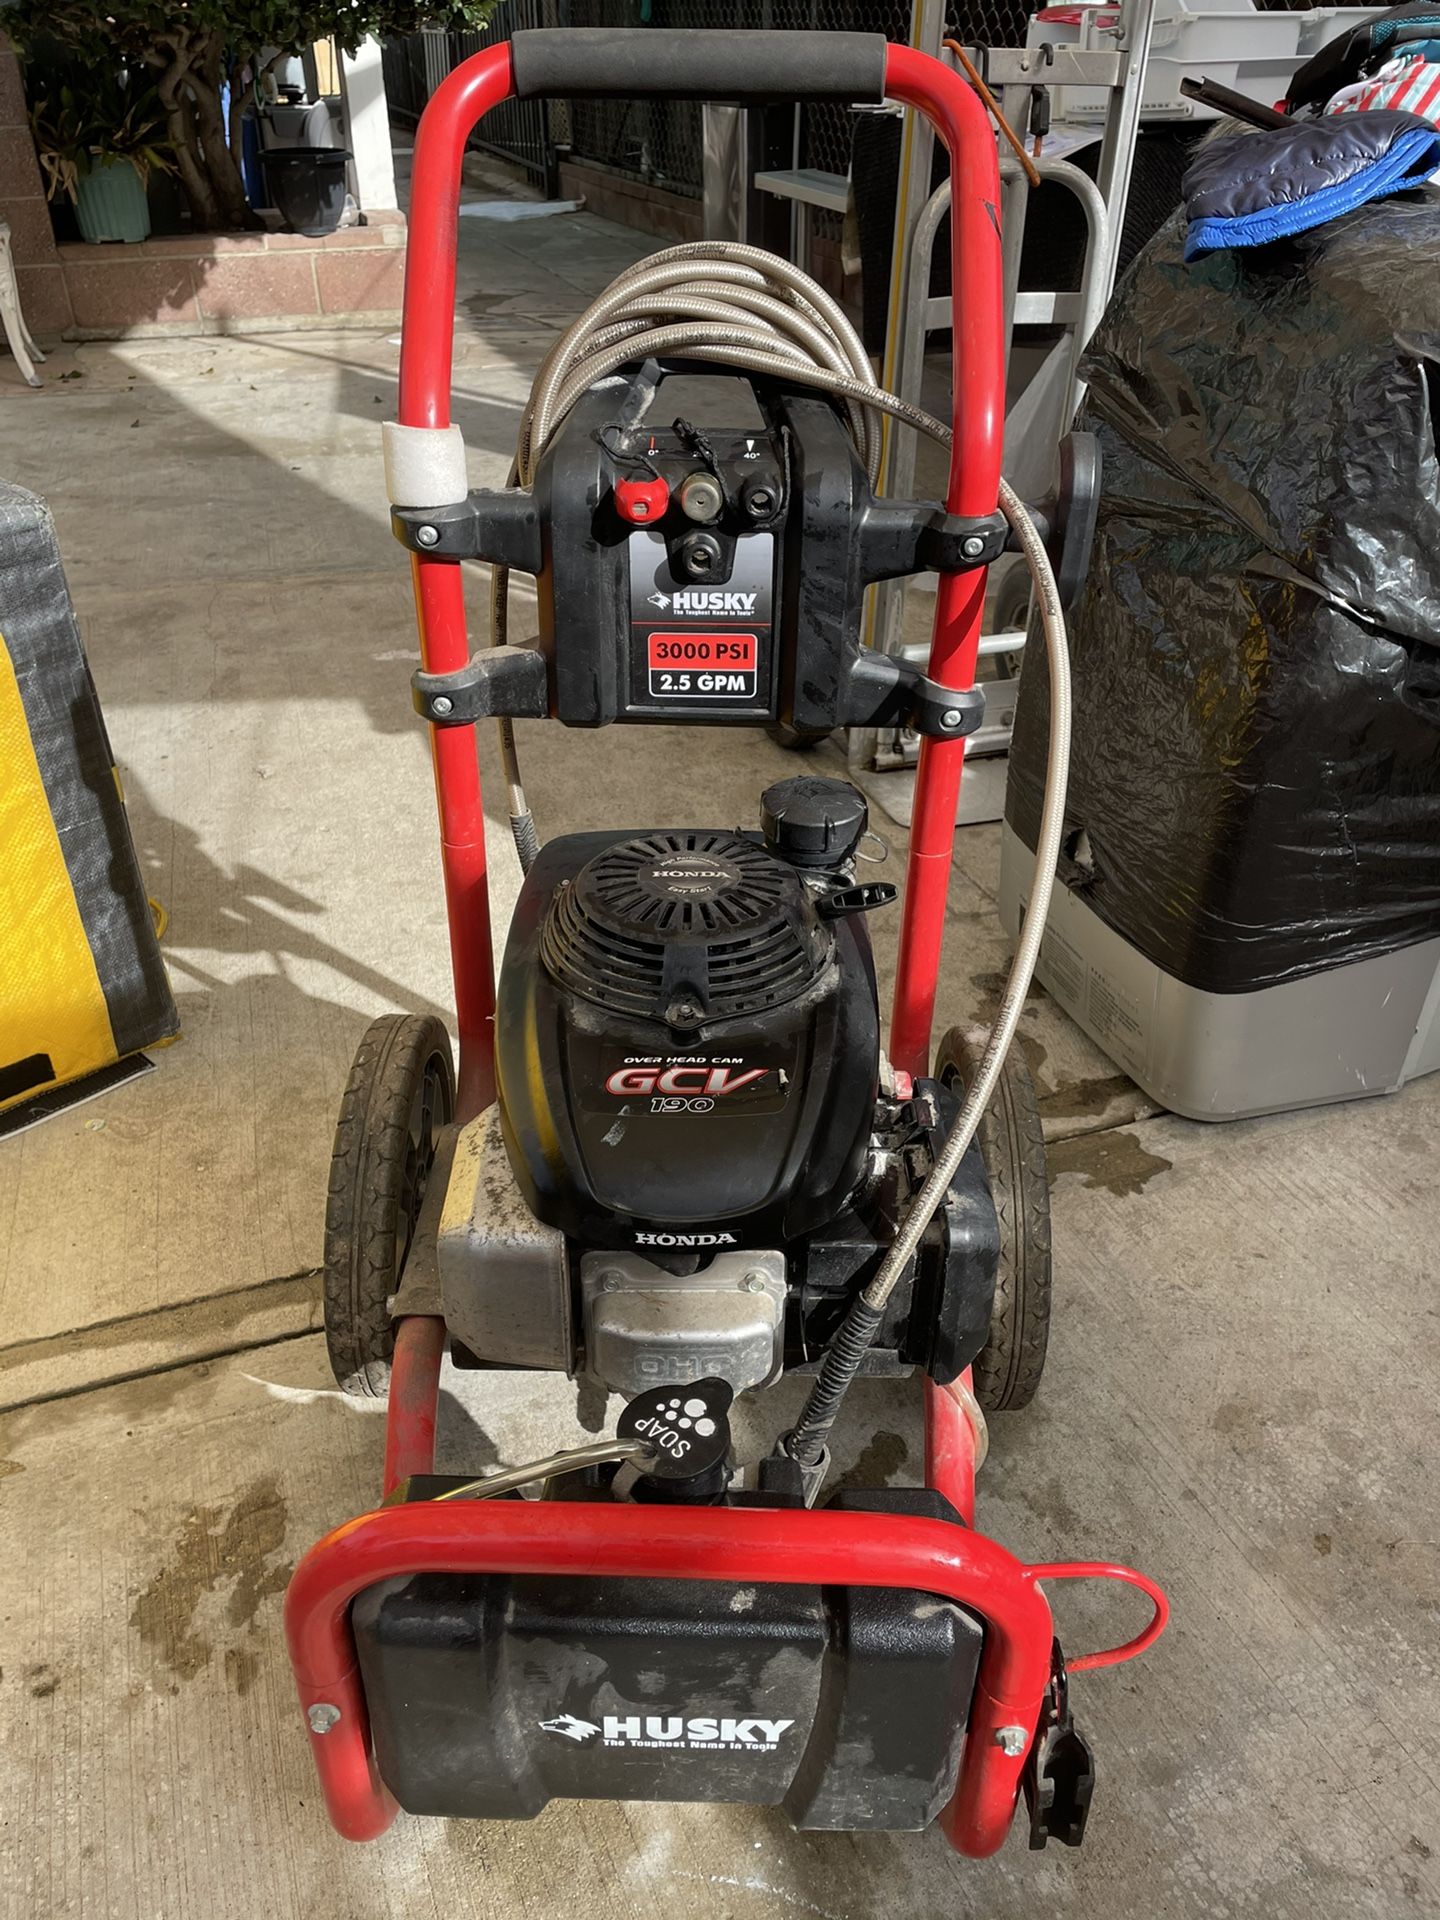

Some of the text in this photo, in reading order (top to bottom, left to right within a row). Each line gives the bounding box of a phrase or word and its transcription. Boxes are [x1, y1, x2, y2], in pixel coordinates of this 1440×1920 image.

[672, 592, 757, 610] HUSKY
[656, 642, 749, 660] 3000 PSI
[660, 674, 746, 691] 2.5 GPM
[652, 870, 732, 878] HONDA
[666, 1056, 707, 1064] HEAD
[605, 1067, 770, 1096] GCV
[651, 1097, 715, 1113] 190
[635, 1232, 737, 1246] HONDA
[634, 1417, 692, 1459] SOAP
[603, 1716, 795, 1743] HUSKY
[603, 1739, 626, 1747] The
[630, 1739, 686, 1749] Toughest
[689, 1741, 726, 1750] Name
